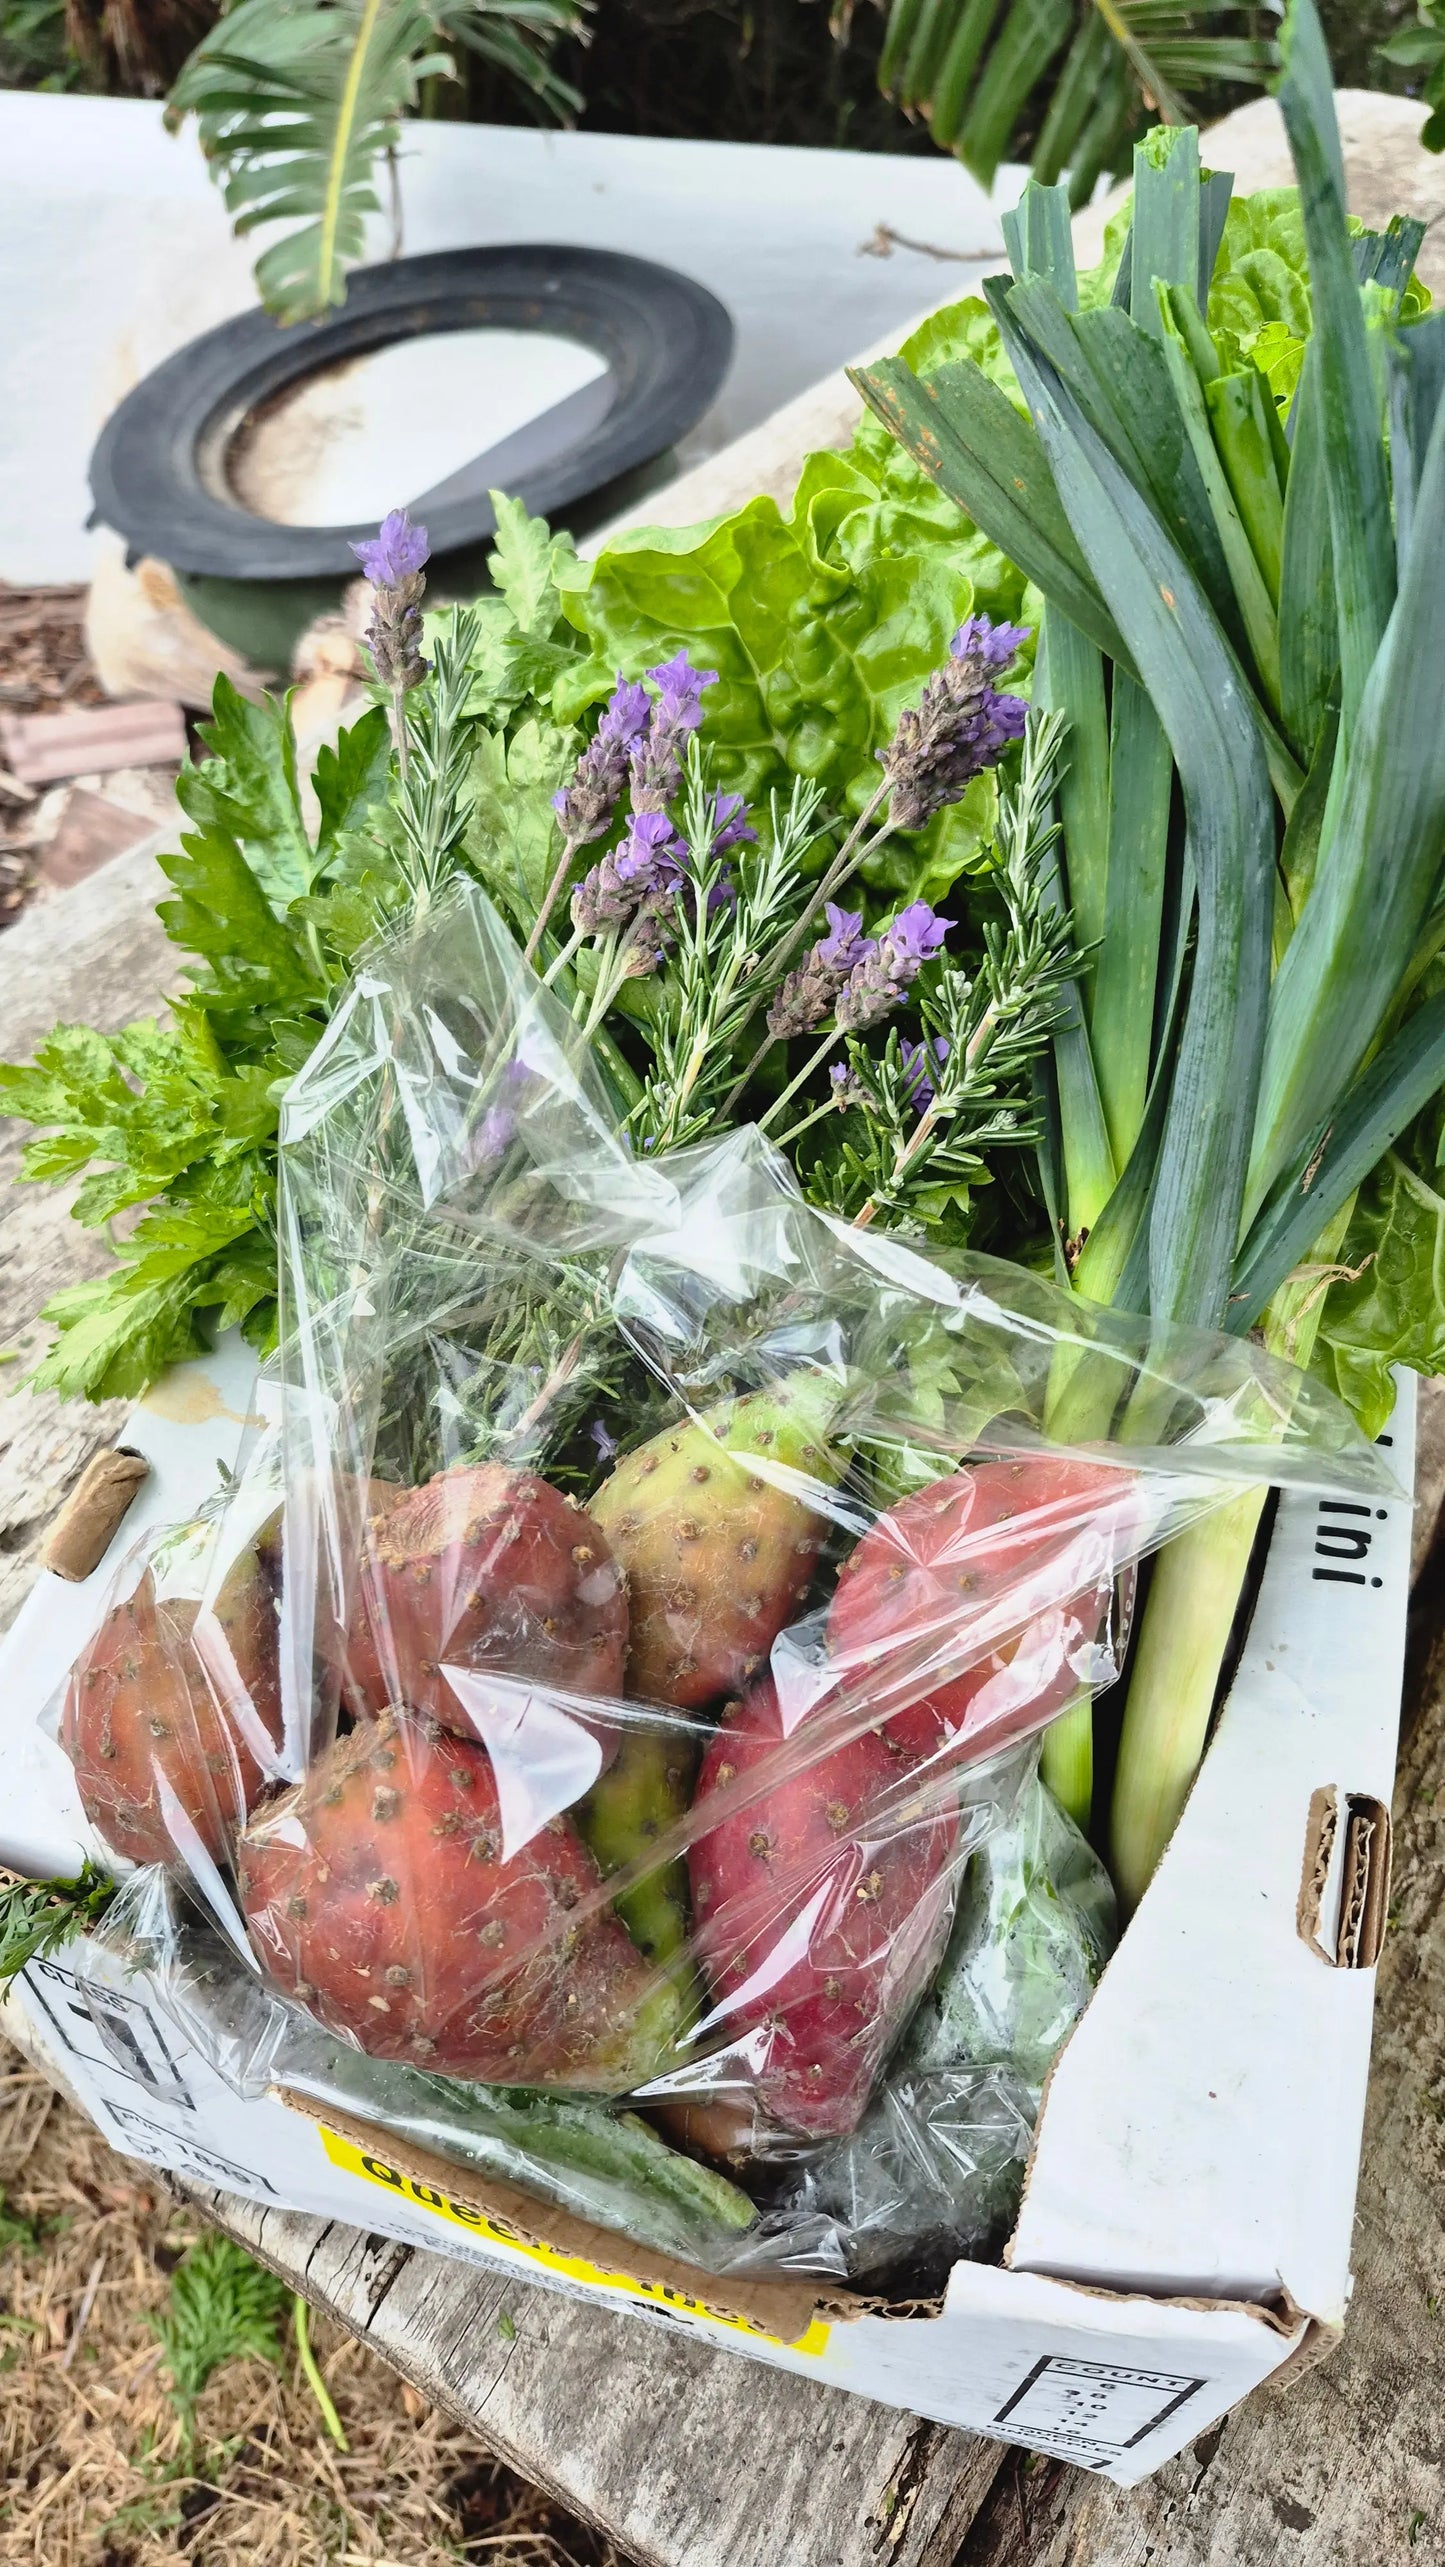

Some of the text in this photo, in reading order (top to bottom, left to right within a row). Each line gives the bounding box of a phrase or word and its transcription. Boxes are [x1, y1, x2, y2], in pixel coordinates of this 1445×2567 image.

[38, 1962, 128, 2012] CLASS
[361, 2156, 554, 2253] Quee
[1055, 2362, 1185, 2387] COUNT
[1065, 2410, 1098, 2419] 12
[1073, 2400, 1107, 2410] 10
[985, 2424, 1122, 2456] PINEAPPLES
[1019, 2427, 1097, 2446] QUEEN
